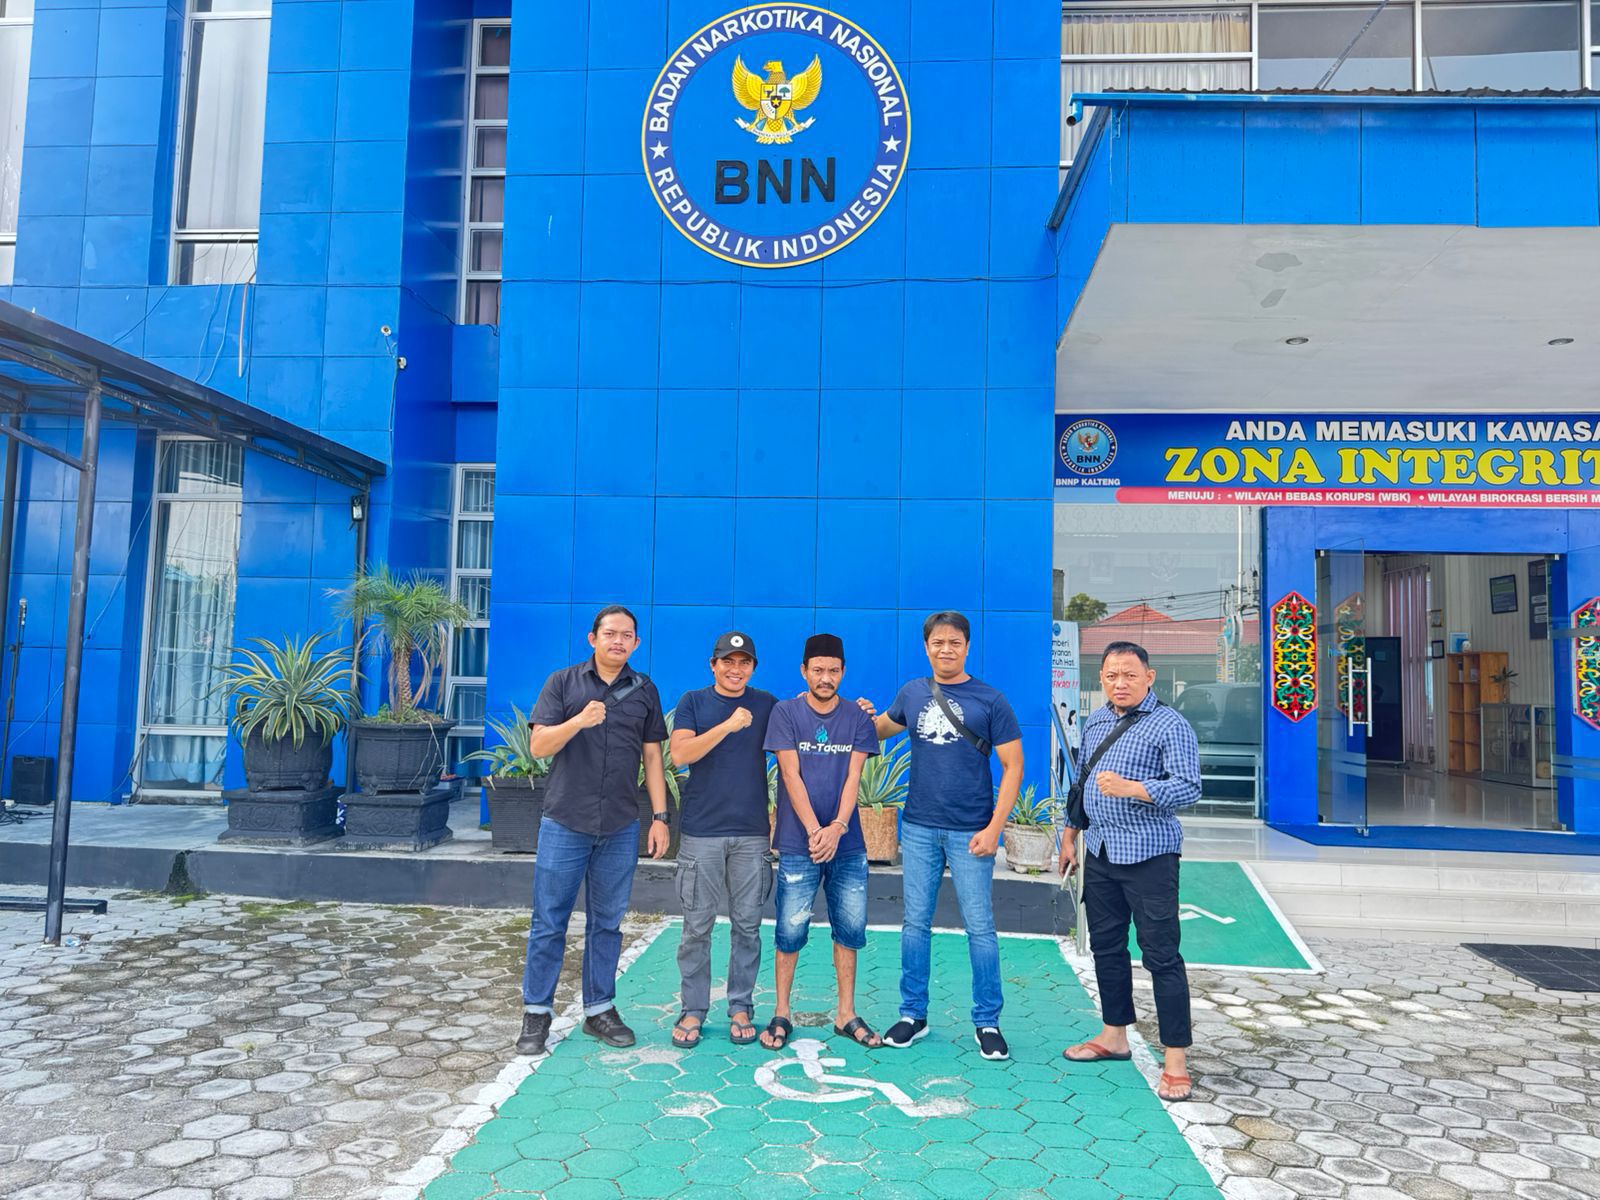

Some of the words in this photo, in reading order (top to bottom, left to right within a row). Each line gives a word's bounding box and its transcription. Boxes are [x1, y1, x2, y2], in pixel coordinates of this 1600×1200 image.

[649, 54, 697, 132] BADAN
[691, 9, 824, 59] NARKOTIKA
[829, 23, 903, 126] NASIONAL
[714, 157, 836, 205] BNN
[654, 166, 764, 260] REPUBLIK
[773, 163, 898, 260] INDONESIA
[1225, 420, 1306, 442] ANDA
[1316, 420, 1476, 442] MEMASUKI
[1076, 455, 1101, 463] BNN
[1164, 447, 1325, 484] ZONA
[1055, 478, 1080, 486] BNNP
[1081, 478, 1121, 486] KALTENG
[1167, 491, 1215, 500] MENUJU
[1234, 491, 1282, 501] WILAYAH
[1286, 492, 1323, 501] BEBAS
[1325, 492, 1375, 502] KORUPSI
[1378, 492, 1411, 502] (WBK)
[1427, 493, 1477, 503] WILAYAH
[1480, 493, 1542, 503] BIROKRASI
[1545, 494, 1588, 503] BERSIH
